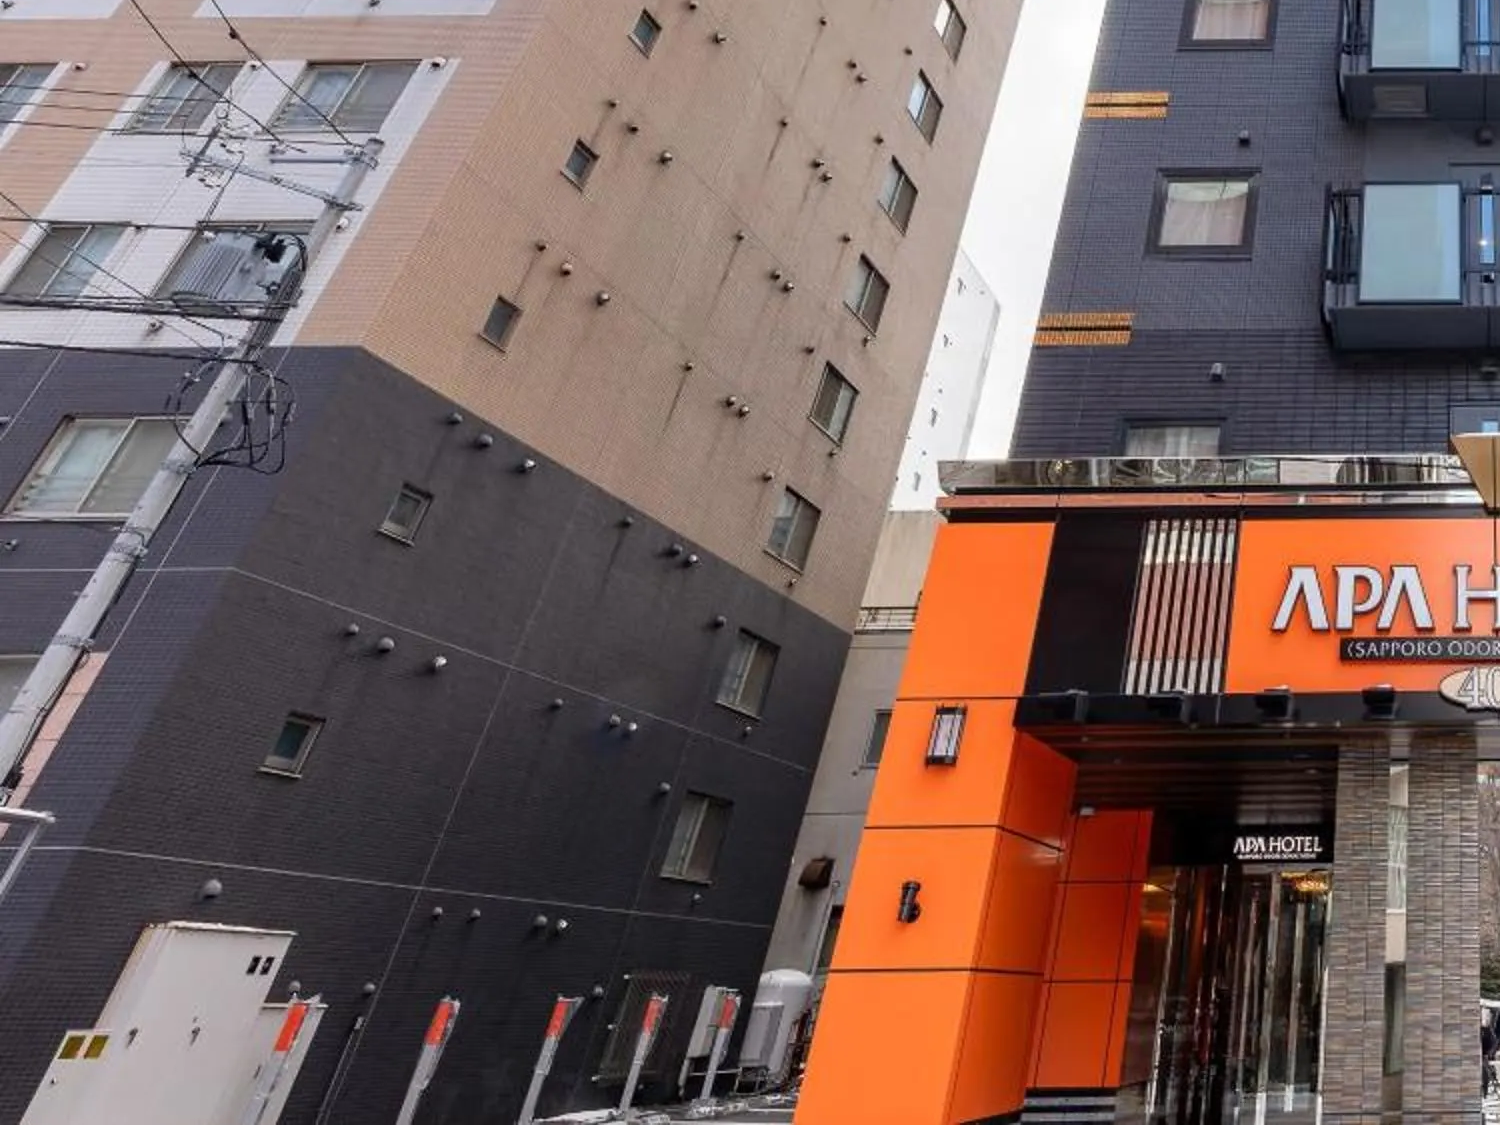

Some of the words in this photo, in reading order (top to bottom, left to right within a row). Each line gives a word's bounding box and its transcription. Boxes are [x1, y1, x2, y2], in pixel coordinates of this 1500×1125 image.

[1271, 565, 1434, 630] APA
[1233, 836, 1266, 853] APA
[1269, 836, 1323, 852] HOTEL
